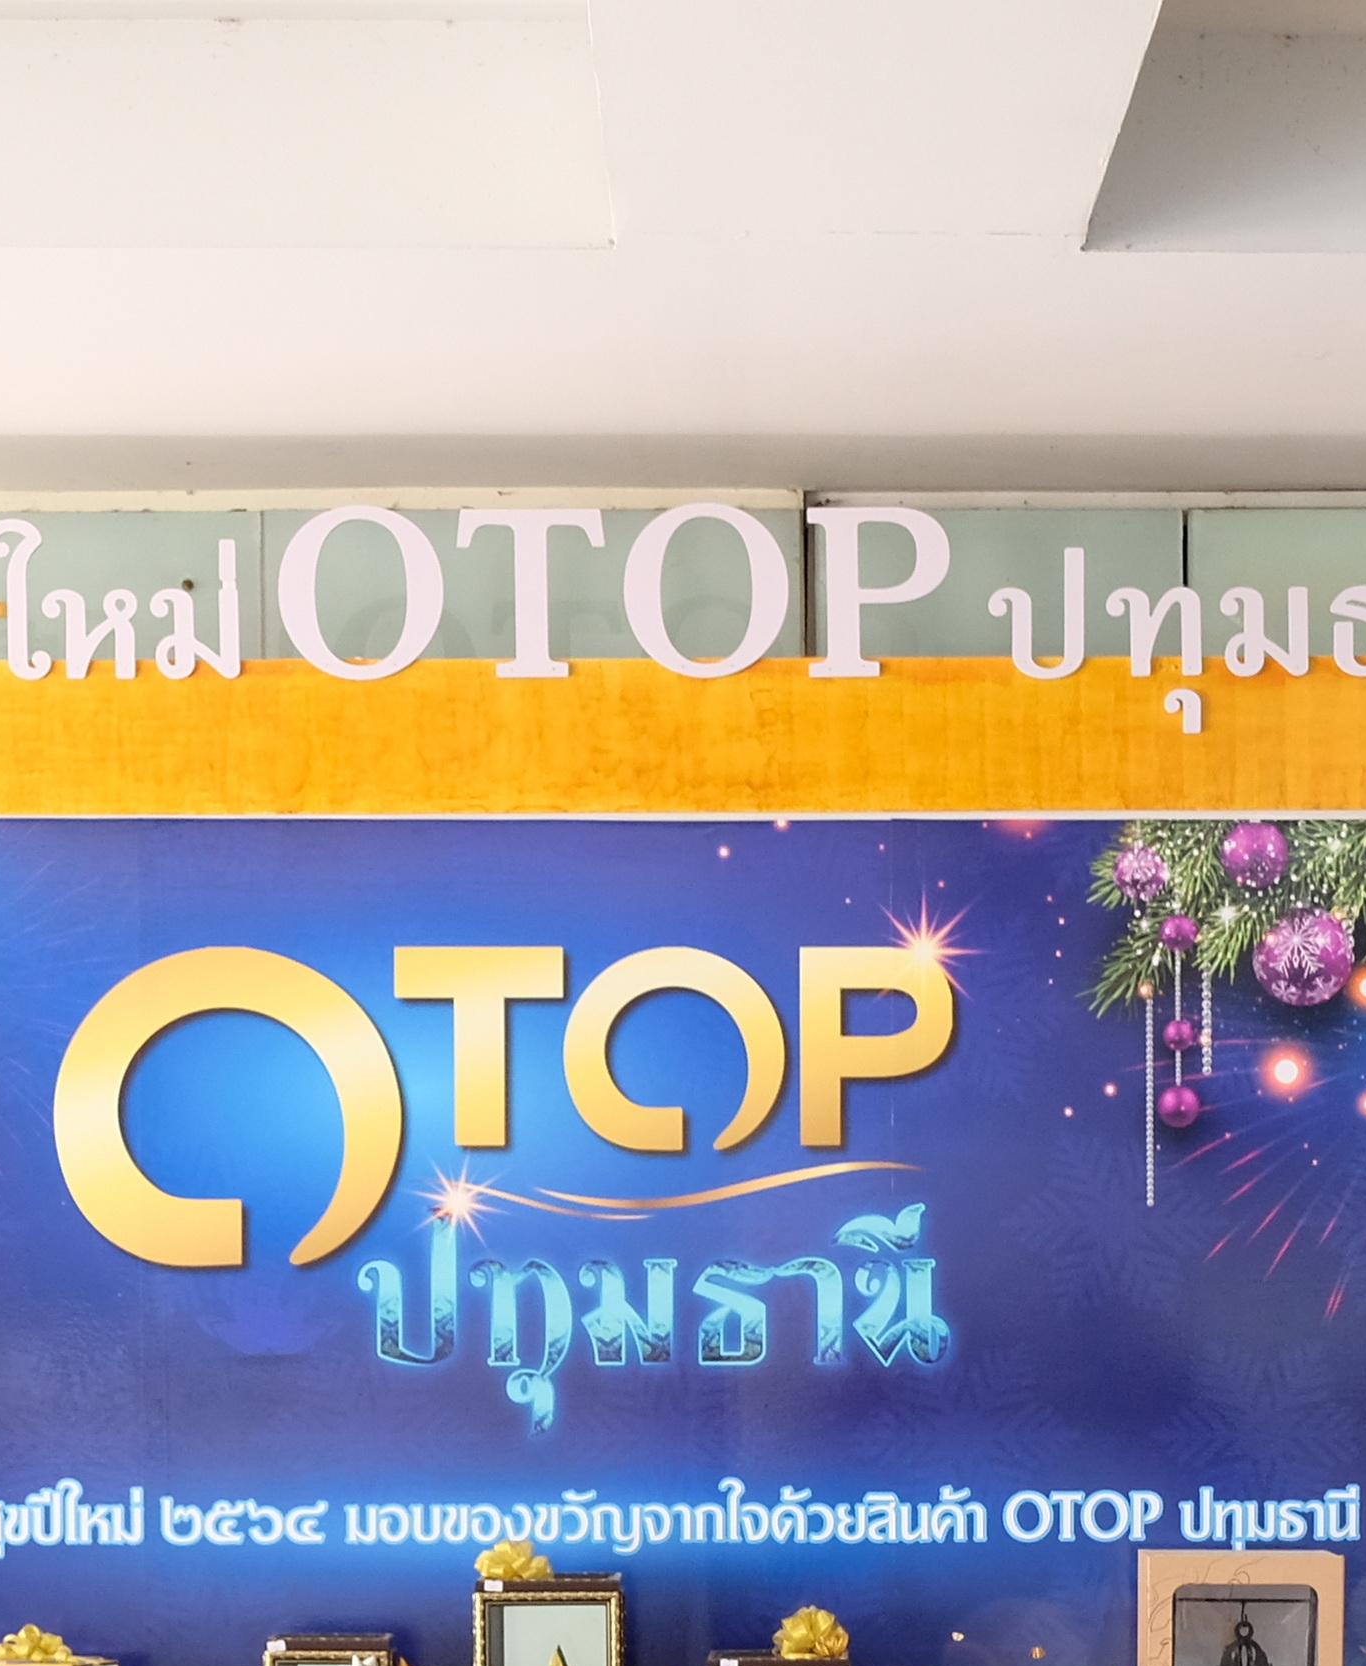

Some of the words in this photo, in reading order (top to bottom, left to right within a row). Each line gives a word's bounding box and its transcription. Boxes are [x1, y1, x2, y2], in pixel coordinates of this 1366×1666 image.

[277, 502, 952, 682] OTOP
[53, 945, 955, 1268] OTOP
[356, 1200, 952, 1437] ปทุมธานี
[160, 1495, 329, 1548] ๒๕๖๔
[344, 1477, 988, 1554] มอบของขวัญจากใจด้วยสินค้า
[1001, 1488, 1163, 1543] OTOP
[1179, 1482, 1362, 1550] ปทุมธานี
